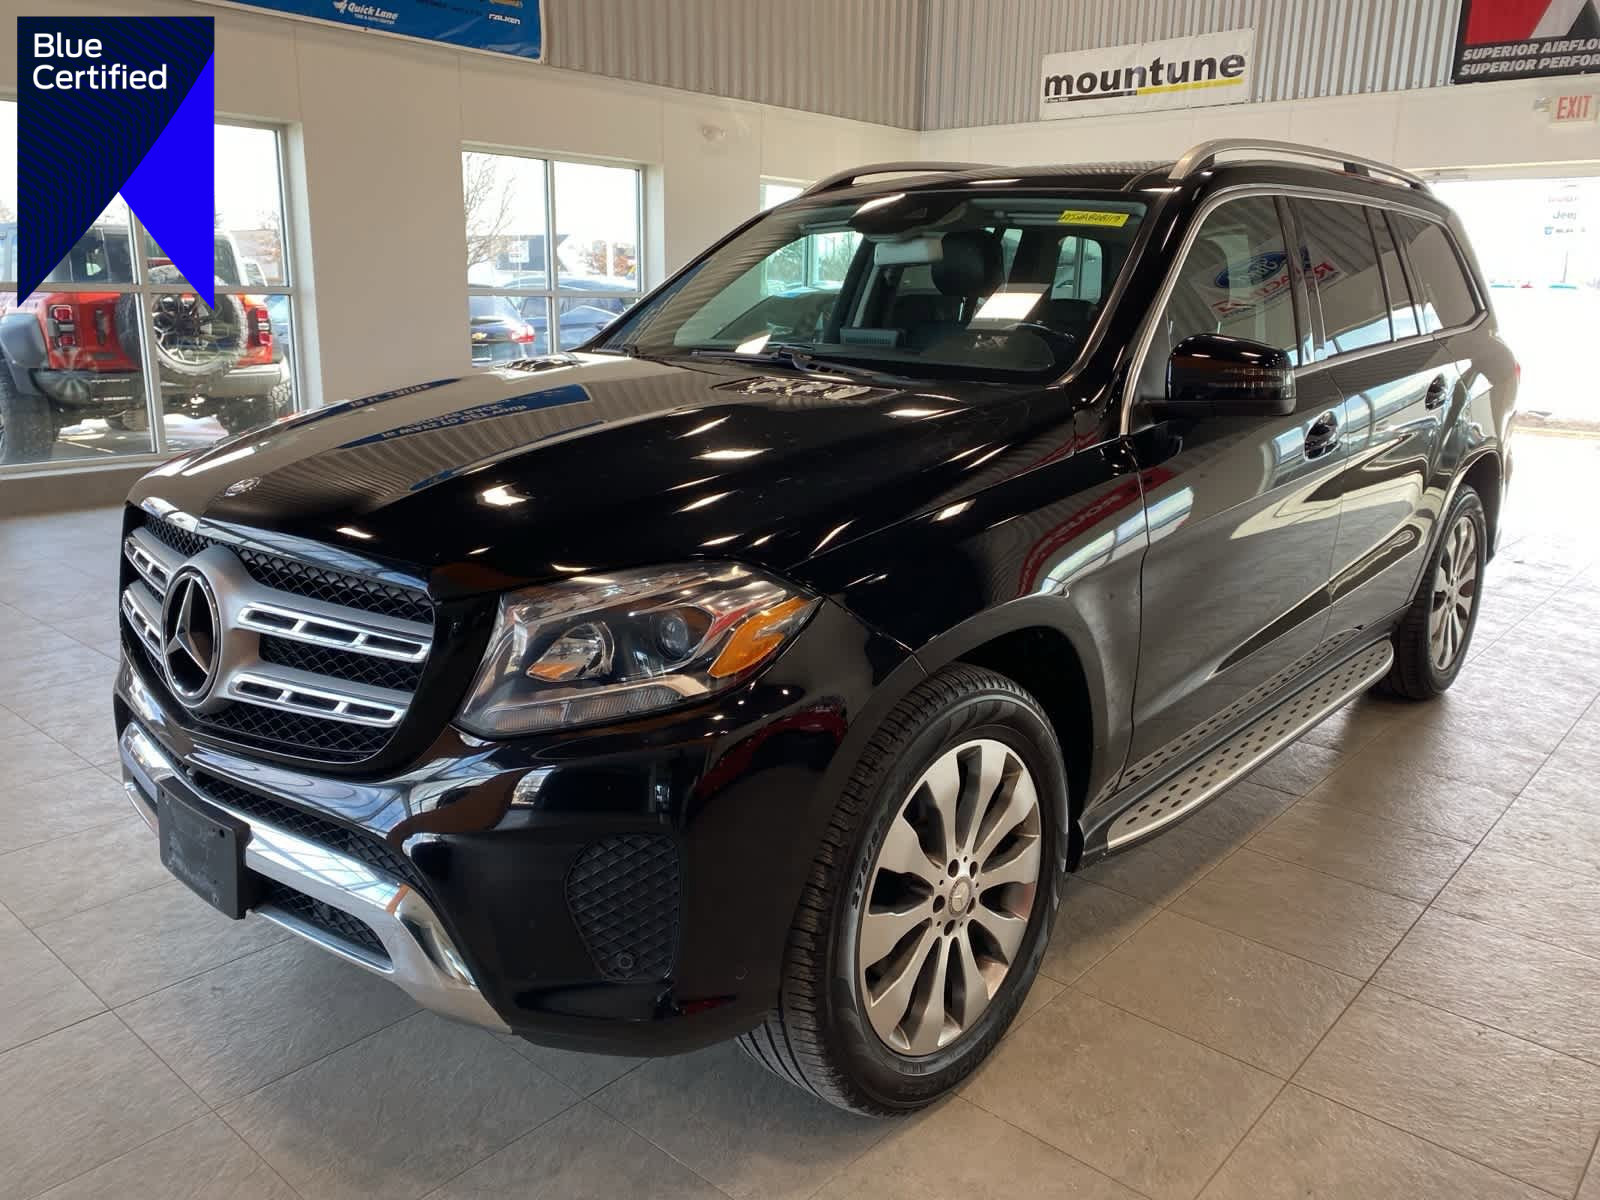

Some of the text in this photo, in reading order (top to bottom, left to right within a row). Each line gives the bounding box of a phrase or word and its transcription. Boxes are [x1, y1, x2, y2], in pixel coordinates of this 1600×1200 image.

[348, 2, 375, 15] Quick
[375, 8, 399, 20] Lane
[488, 13, 520, 24] FALKEN
[1463, 38, 1600, 60] SUPERIOR AIRFLO
[1460, 53, 1600, 75] SUPERIOR PERFOR
[1044, 54, 1246, 97] mountune
[1556, 95, 1592, 120] EXIT
